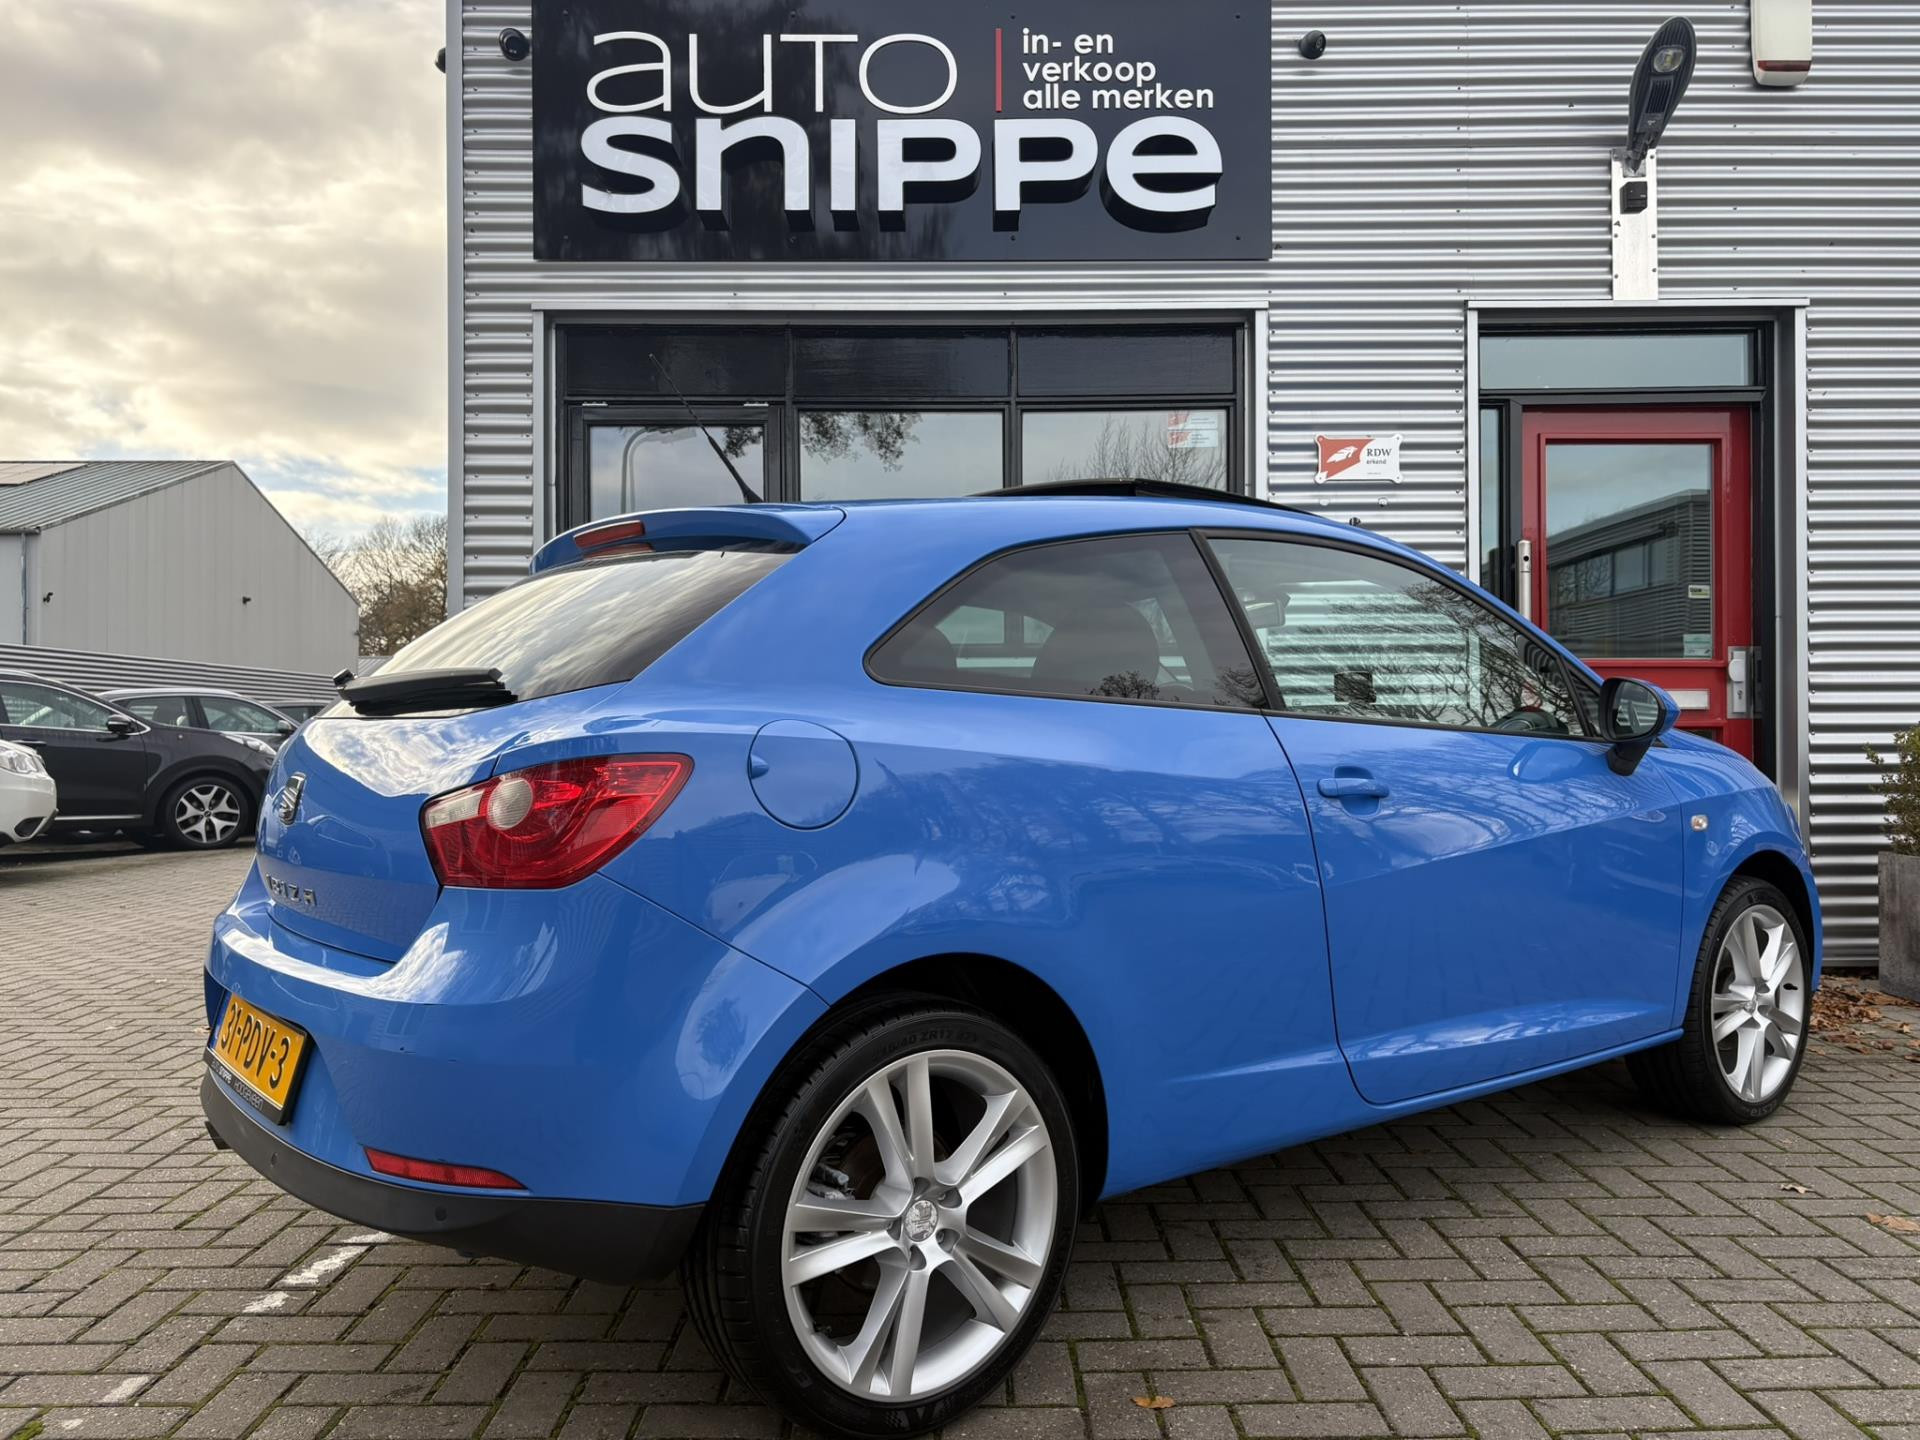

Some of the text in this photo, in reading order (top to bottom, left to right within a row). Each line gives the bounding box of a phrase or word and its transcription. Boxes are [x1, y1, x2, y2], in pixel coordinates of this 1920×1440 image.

[1022, 27, 1114, 54] in- en
[1022, 55, 1156, 88] verkoop
[1022, 82, 1214, 110] alle merken
[1366, 448, 1392, 457] RDW
[221, 1002, 291, 1089] 31-PDV-3
